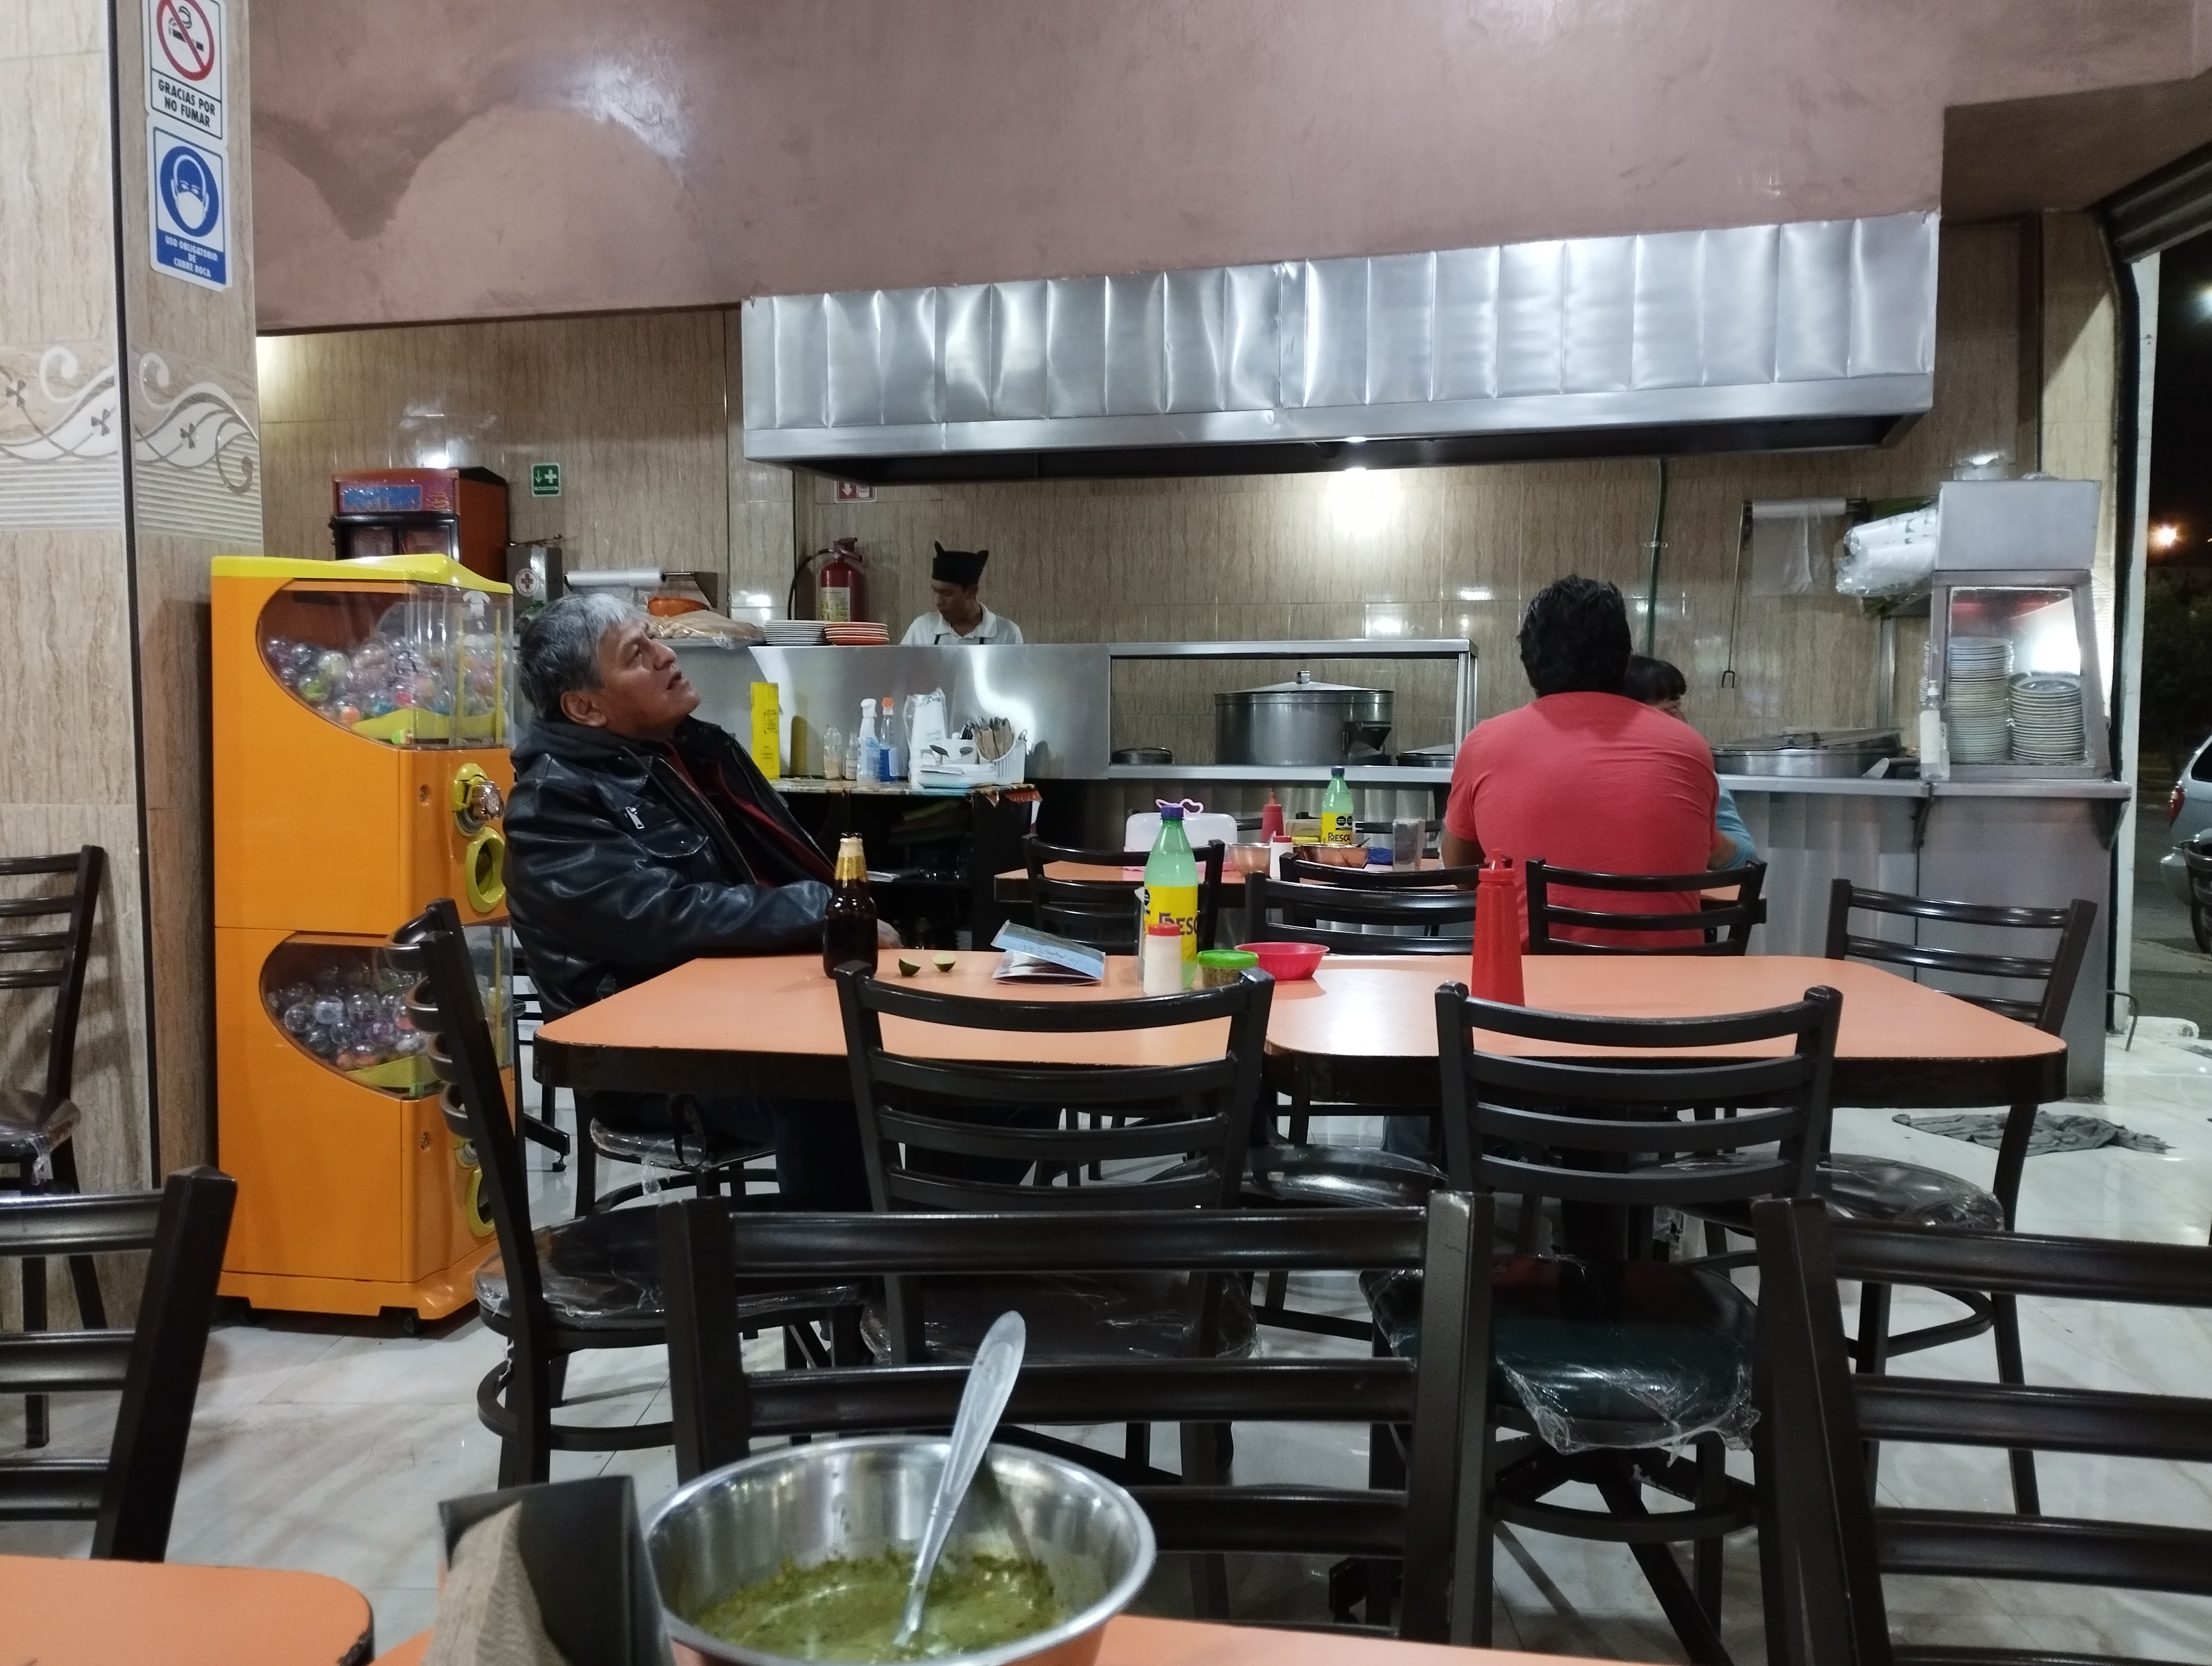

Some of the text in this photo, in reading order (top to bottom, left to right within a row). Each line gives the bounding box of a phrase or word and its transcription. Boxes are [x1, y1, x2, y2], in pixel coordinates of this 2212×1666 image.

[158, 79, 215, 116] GRACIAS POR
[164, 96, 210, 127] NO FUMAR
[165, 234, 218, 261] USO OBLIGATORIO
[188, 253, 196, 264] DE
[174, 257, 211, 277] CUBRE BOCA
